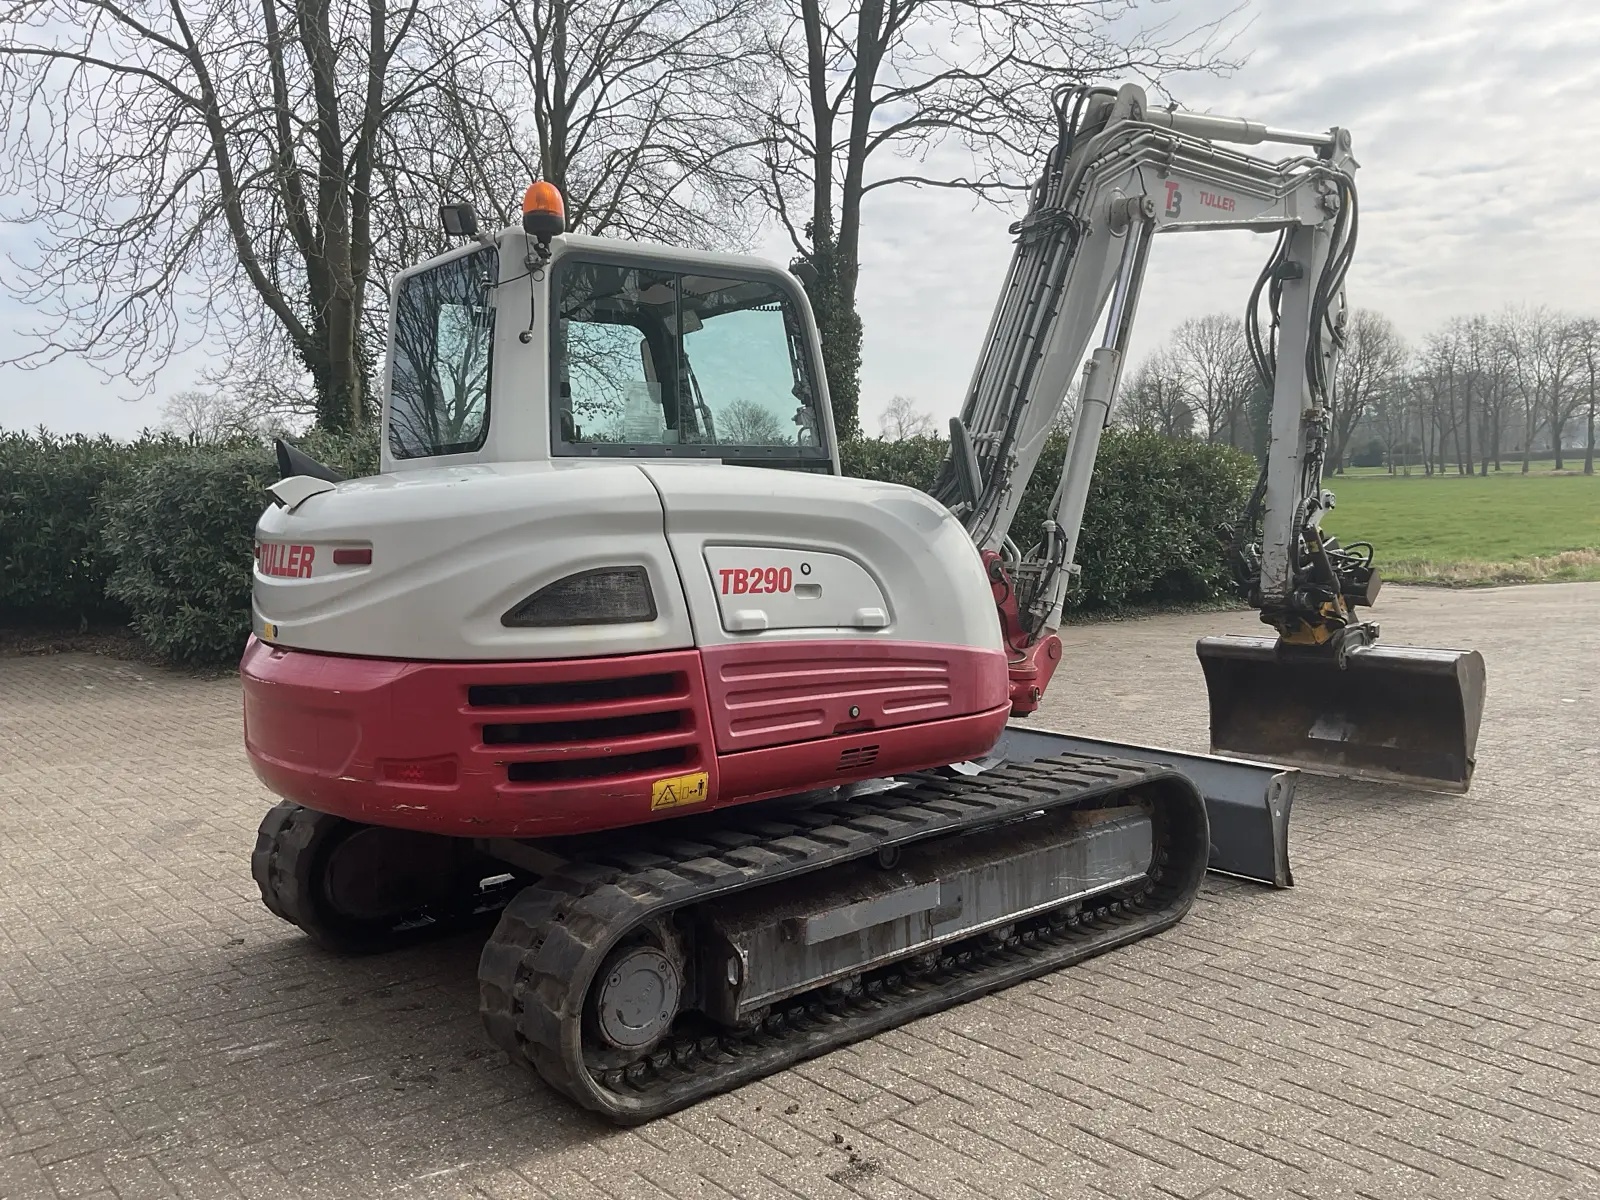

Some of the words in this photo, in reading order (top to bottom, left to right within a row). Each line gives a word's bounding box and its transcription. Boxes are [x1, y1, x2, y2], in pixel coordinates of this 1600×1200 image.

[1199, 191, 1236, 212] TULLER
[261, 543, 316, 579] TULLER
[719, 567, 793, 595] TB290
